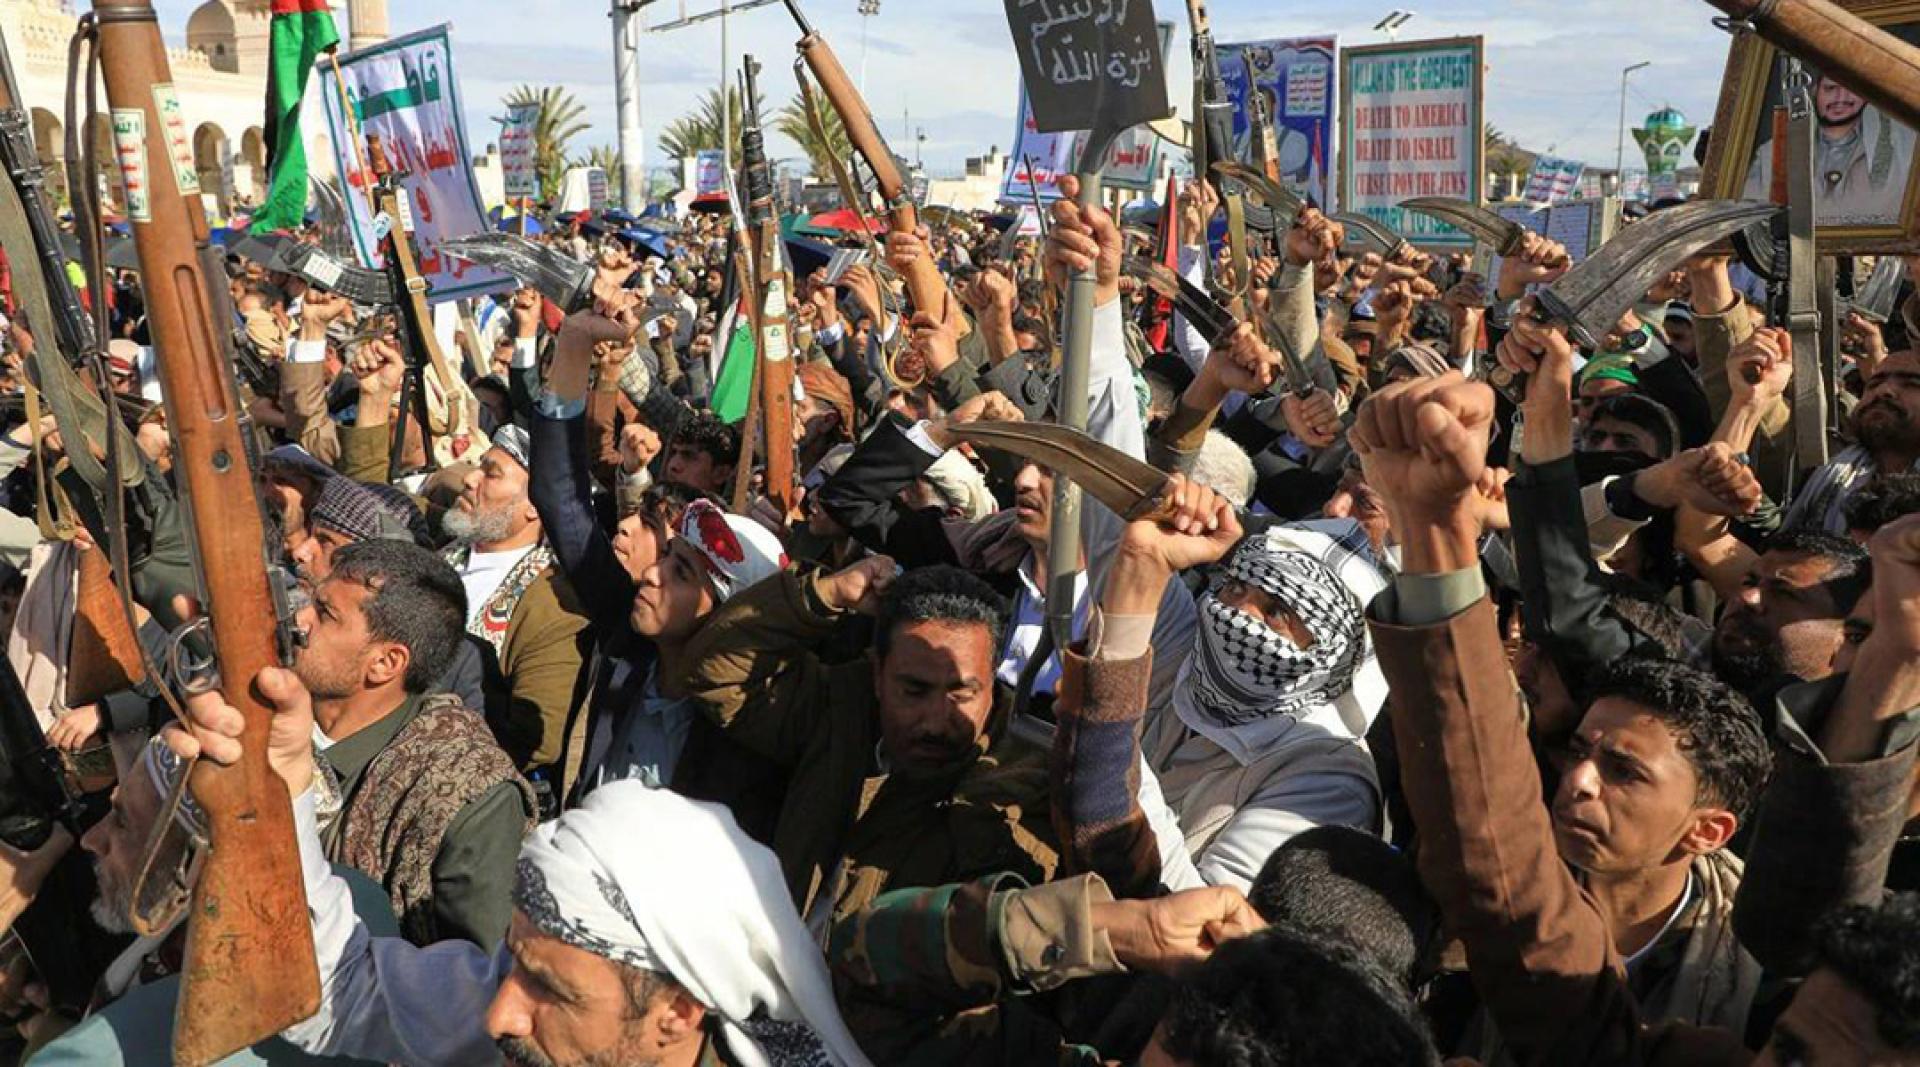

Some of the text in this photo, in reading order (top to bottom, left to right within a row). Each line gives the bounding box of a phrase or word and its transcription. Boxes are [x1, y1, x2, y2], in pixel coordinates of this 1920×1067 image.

[1355, 102, 1468, 129] DEATH TO AMERICA
[1355, 136, 1457, 161] DEATH TO ISRAEL
[1416, 172, 1437, 195] THE
[1439, 171, 1468, 195] JEWS
